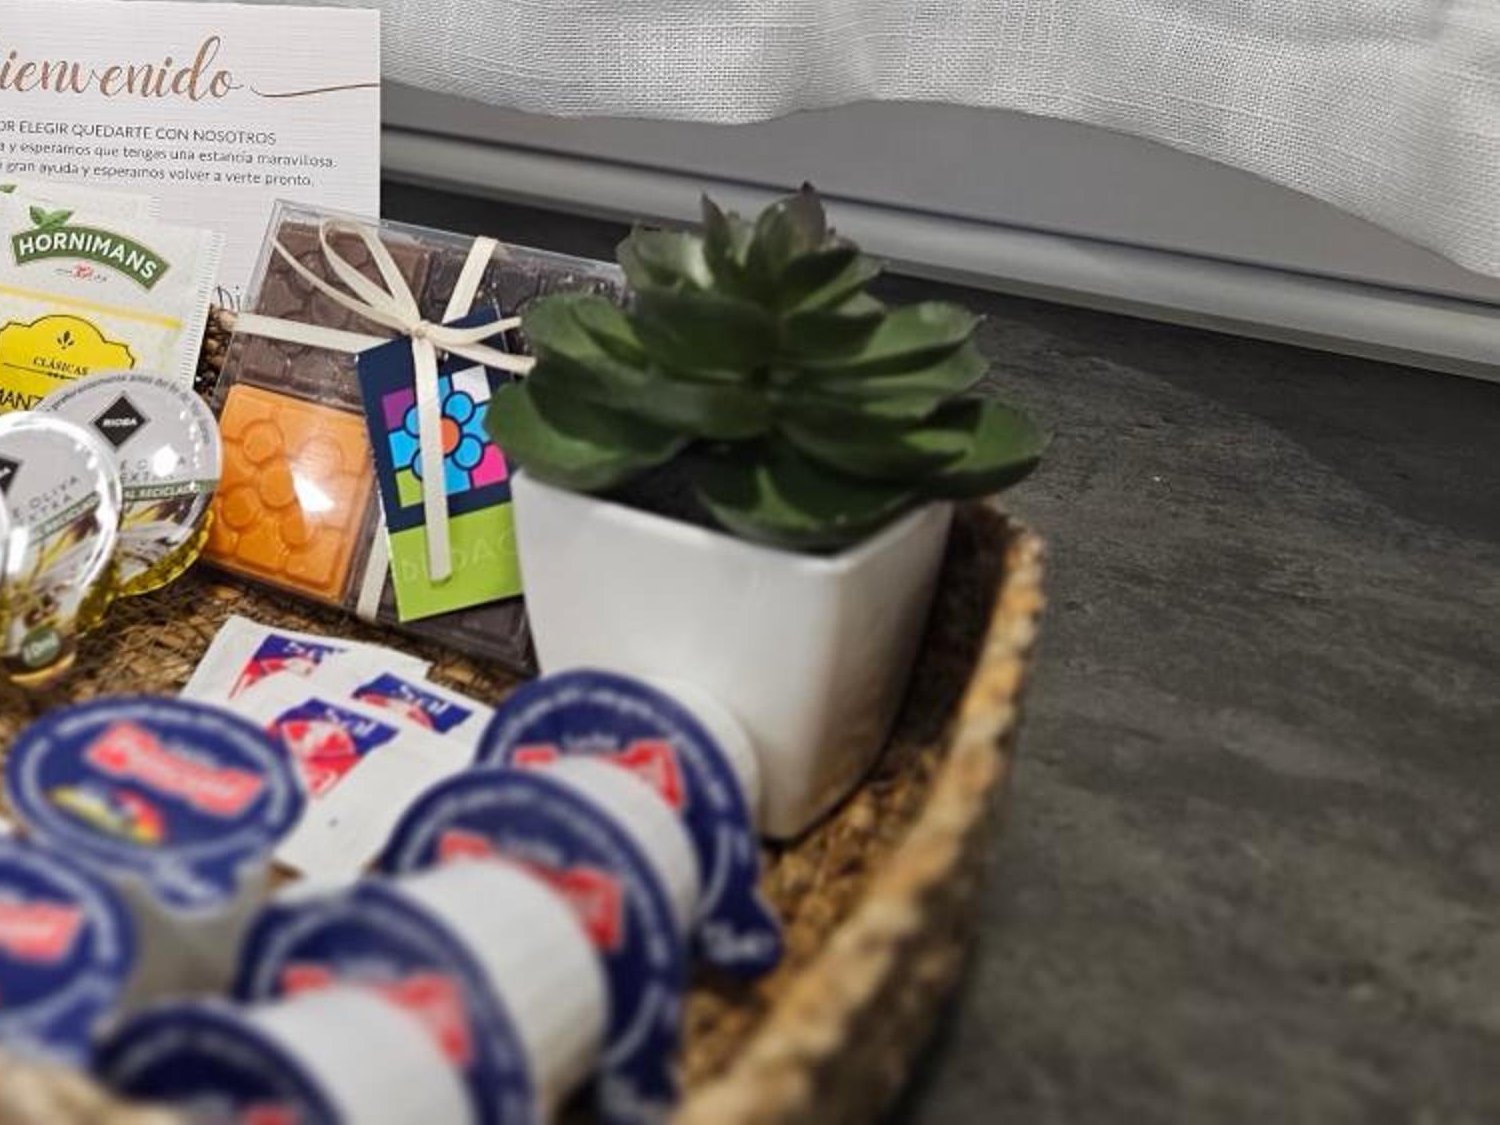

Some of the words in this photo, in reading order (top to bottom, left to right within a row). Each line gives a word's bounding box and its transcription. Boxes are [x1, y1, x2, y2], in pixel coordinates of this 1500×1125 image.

[19, 120, 68, 136] ELEGIR
[72, 123, 151, 140] QUEDARTE
[155, 127, 189, 141] CON
[193, 129, 277, 145] NOSOTROS
[8, 143, 17, 155] y
[20, 143, 91, 157] esperamos
[94, 146, 119, 159] que
[123, 146, 167, 162] tengas
[170, 150, 195, 161] una
[200, 150, 253, 164] estancia
[257, 154, 338, 168] maravillosa.
[5, 161, 35, 174] gran
[39, 161, 79, 176] ayuda
[82, 166, 91, 178] y
[94, 165, 165, 180] esperamos
[169, 167, 210, 180] volver
[214, 172, 221, 182] a
[225, 172, 261, 184] verte
[265, 174, 315, 188] pronto.
[18, 230, 158, 281] HORNIMANS
[33, 355, 88, 377] CLÁSICAS
[102, 417, 138, 428] RIOBA
